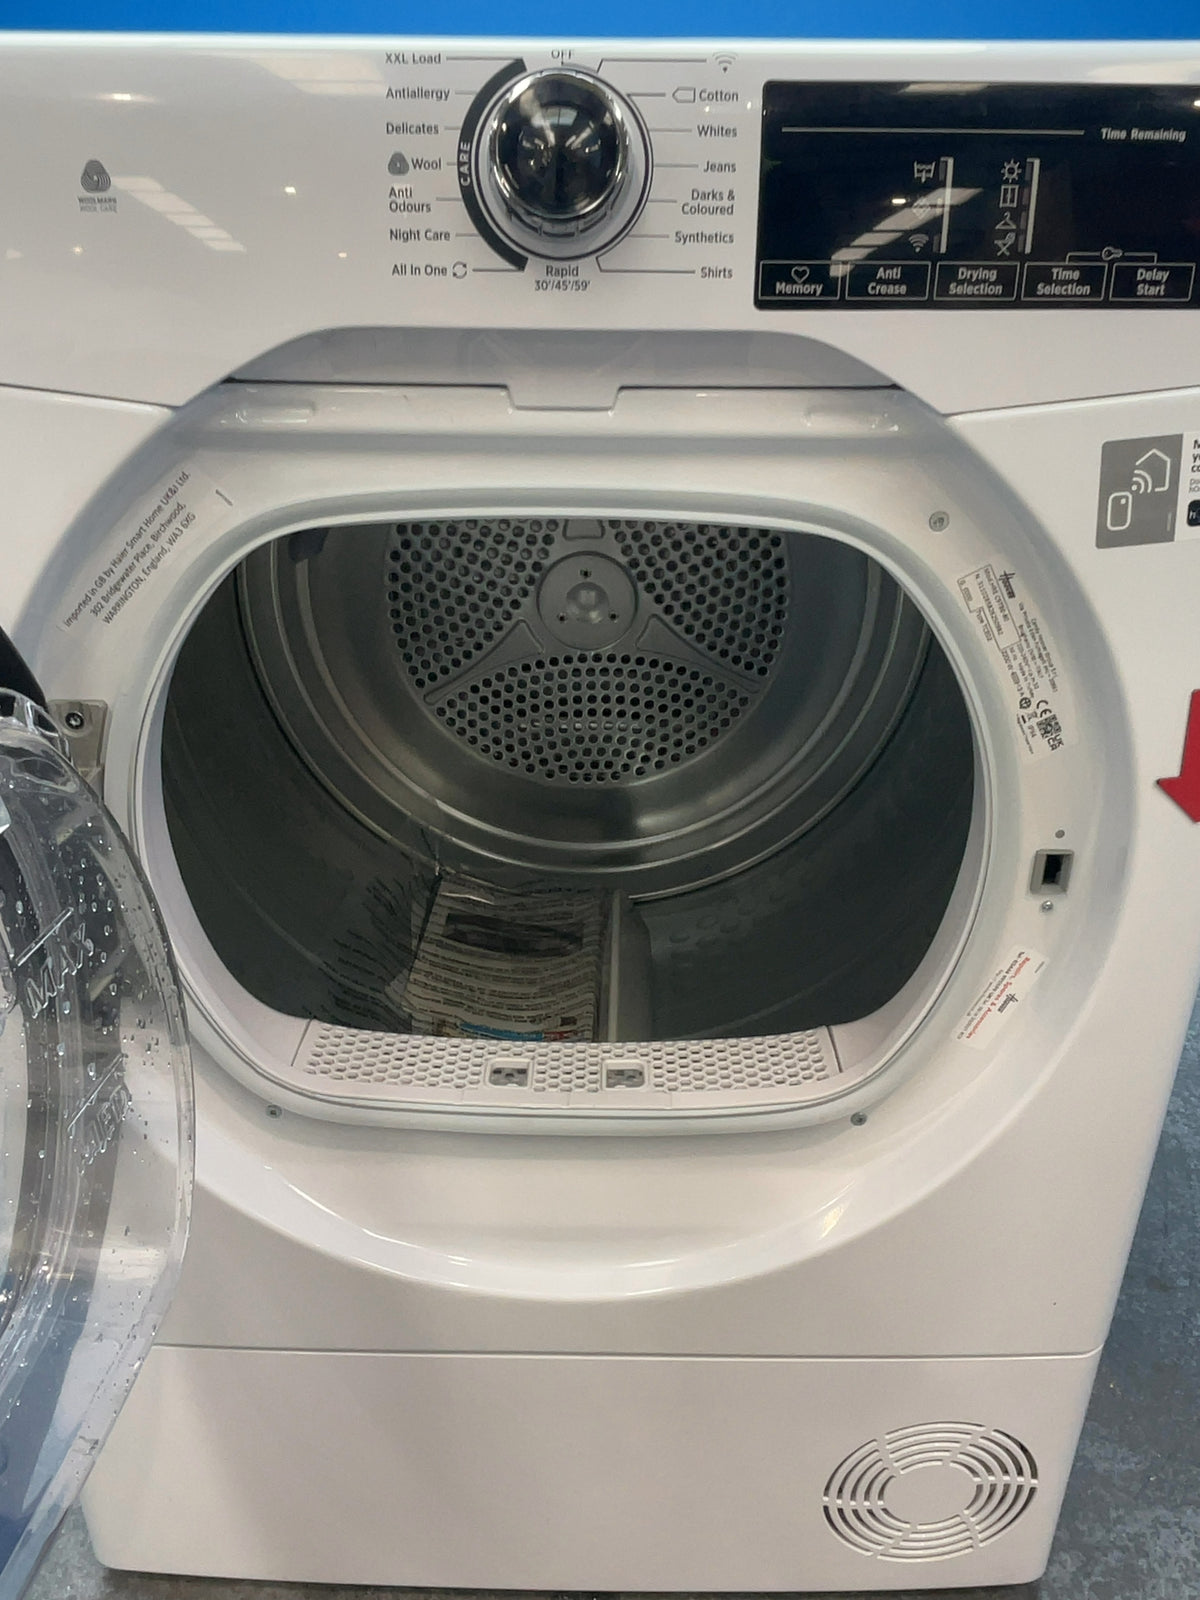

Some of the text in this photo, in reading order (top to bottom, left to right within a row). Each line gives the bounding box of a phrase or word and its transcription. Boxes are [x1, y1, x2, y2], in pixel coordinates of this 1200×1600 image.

[385, 53, 441, 64] XXL Load
[386, 87, 450, 102] Antiallergy
[699, 88, 739, 102] Cotton
[386, 122, 439, 135] Delicates
[697, 124, 738, 137] Whites
[1101, 127, 1186, 143] Time Remaining
[411, 157, 442, 170] Wool
[460, 141, 471, 186] CARE
[703, 160, 737, 173] Jeans
[389, 186, 413, 199] Anti
[691, 188, 735, 201] Darks &
[389, 201, 431, 213] Odours
[681, 202, 734, 216] Coloured
[389, 228, 451, 243] Night Care
[675, 230, 734, 246] Synthetics
[392, 264, 448, 276] All In One
[546, 265, 579, 279] Rapid
[700, 266, 733, 279] Shirts
[876, 266, 902, 280] Anti
[957, 266, 998, 282] Drying
[1051, 267, 1080, 280] Time
[1136, 268, 1170, 283] Delay
[775, 282, 823, 296] Memory
[867, 282, 907, 296] Crease
[949, 283, 1003, 296] Selection
[1037, 283, 1091, 296] Selection
[1136, 284, 1166, 296] Start
[166, 527, 184, 546] WA3
[94, 575, 107, 589] GB
[102, 567, 115, 578] by
[125, 526, 147, 550] Smart
[142, 504, 164, 528] Home
[100, 561, 137, 604] Bridgewater
[25, 921, 94, 1019] MAX
